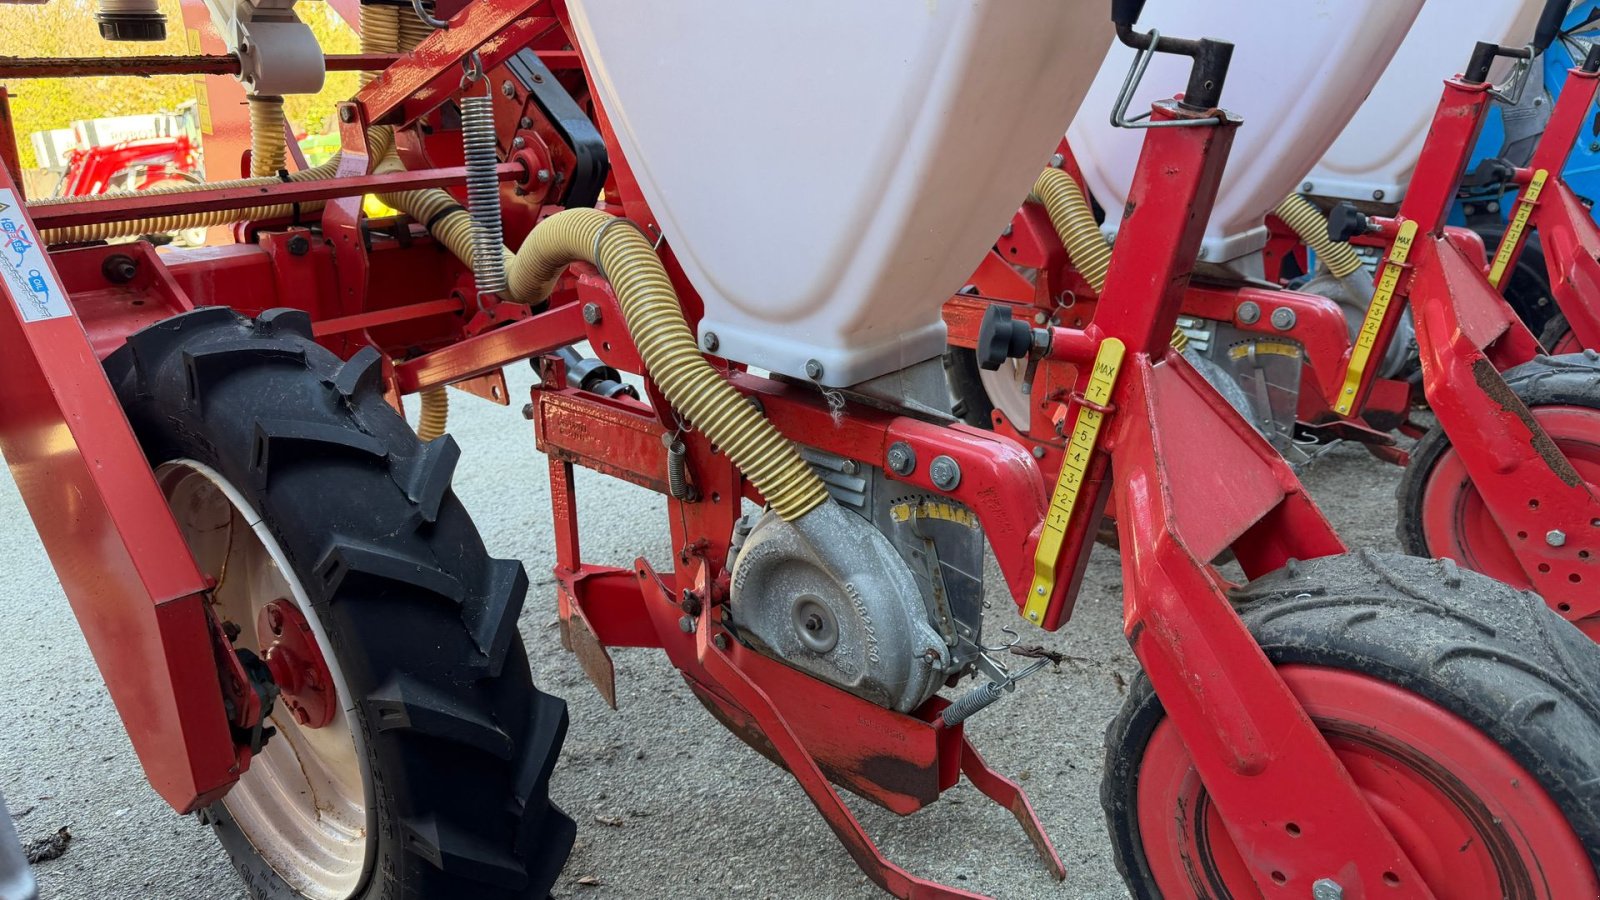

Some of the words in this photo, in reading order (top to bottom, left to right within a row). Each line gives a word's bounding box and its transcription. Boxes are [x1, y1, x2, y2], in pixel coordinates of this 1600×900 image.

[1397, 235, 1411, 246] MAX
[33, 277, 43, 290] OIL
[1095, 362, 1115, 378] MAX
